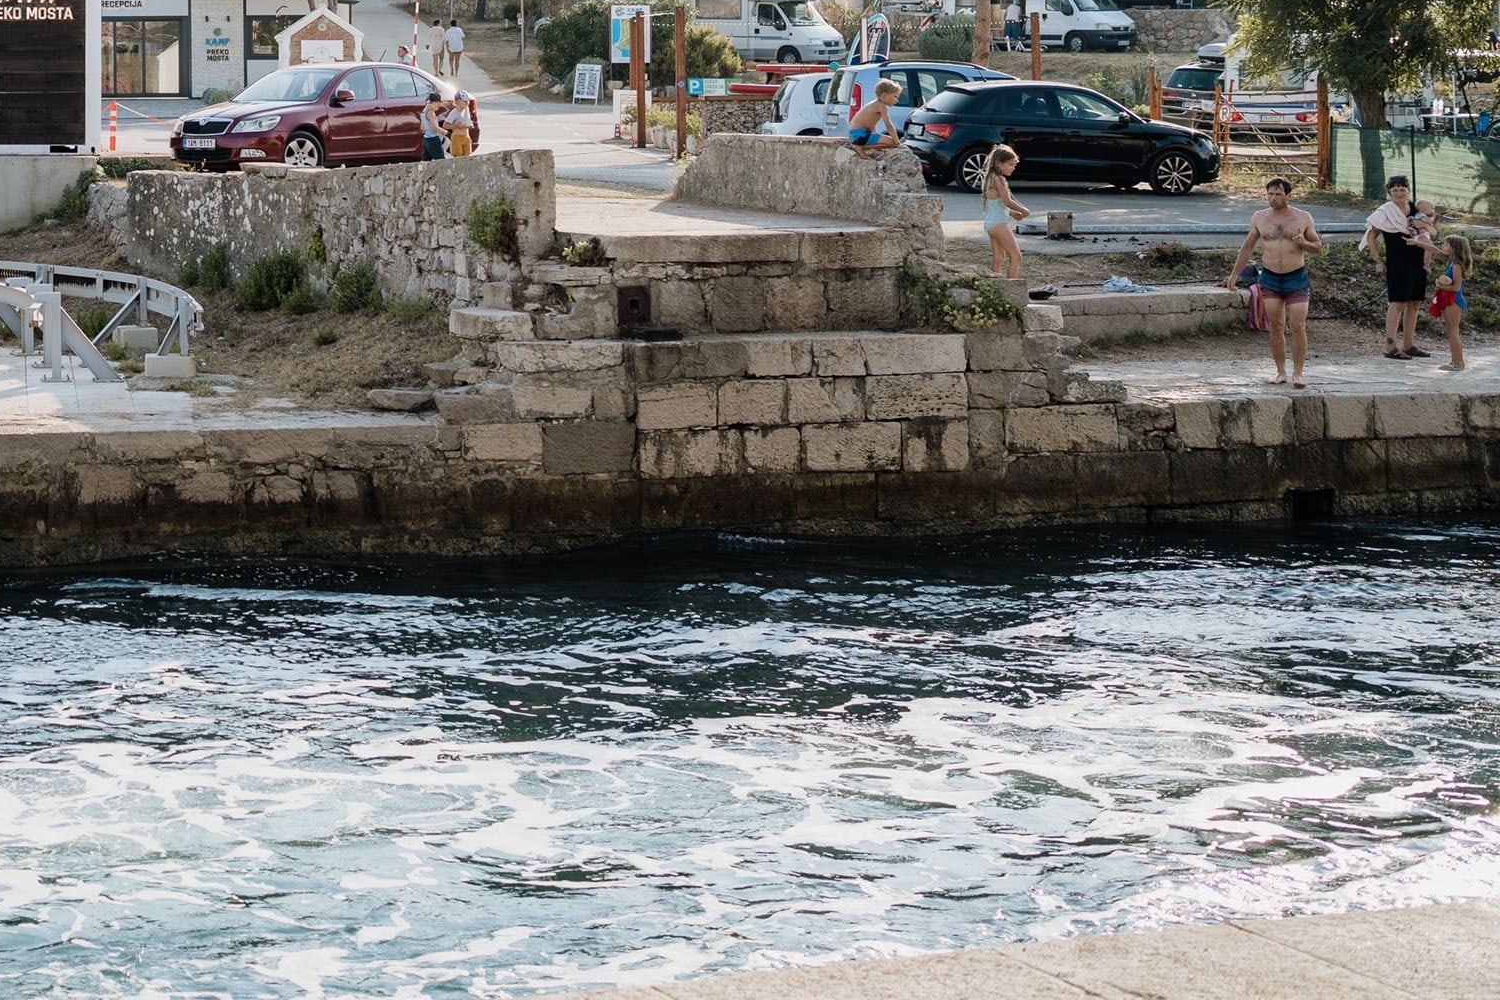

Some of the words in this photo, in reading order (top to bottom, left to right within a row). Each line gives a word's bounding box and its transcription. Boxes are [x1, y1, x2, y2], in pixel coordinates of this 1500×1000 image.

[101, 0, 143, 8] RECEPCIJA
[26, 6, 74, 20] MOSTA
[205, 38, 230, 46] KAMP
[690, 80, 700, 95] P
